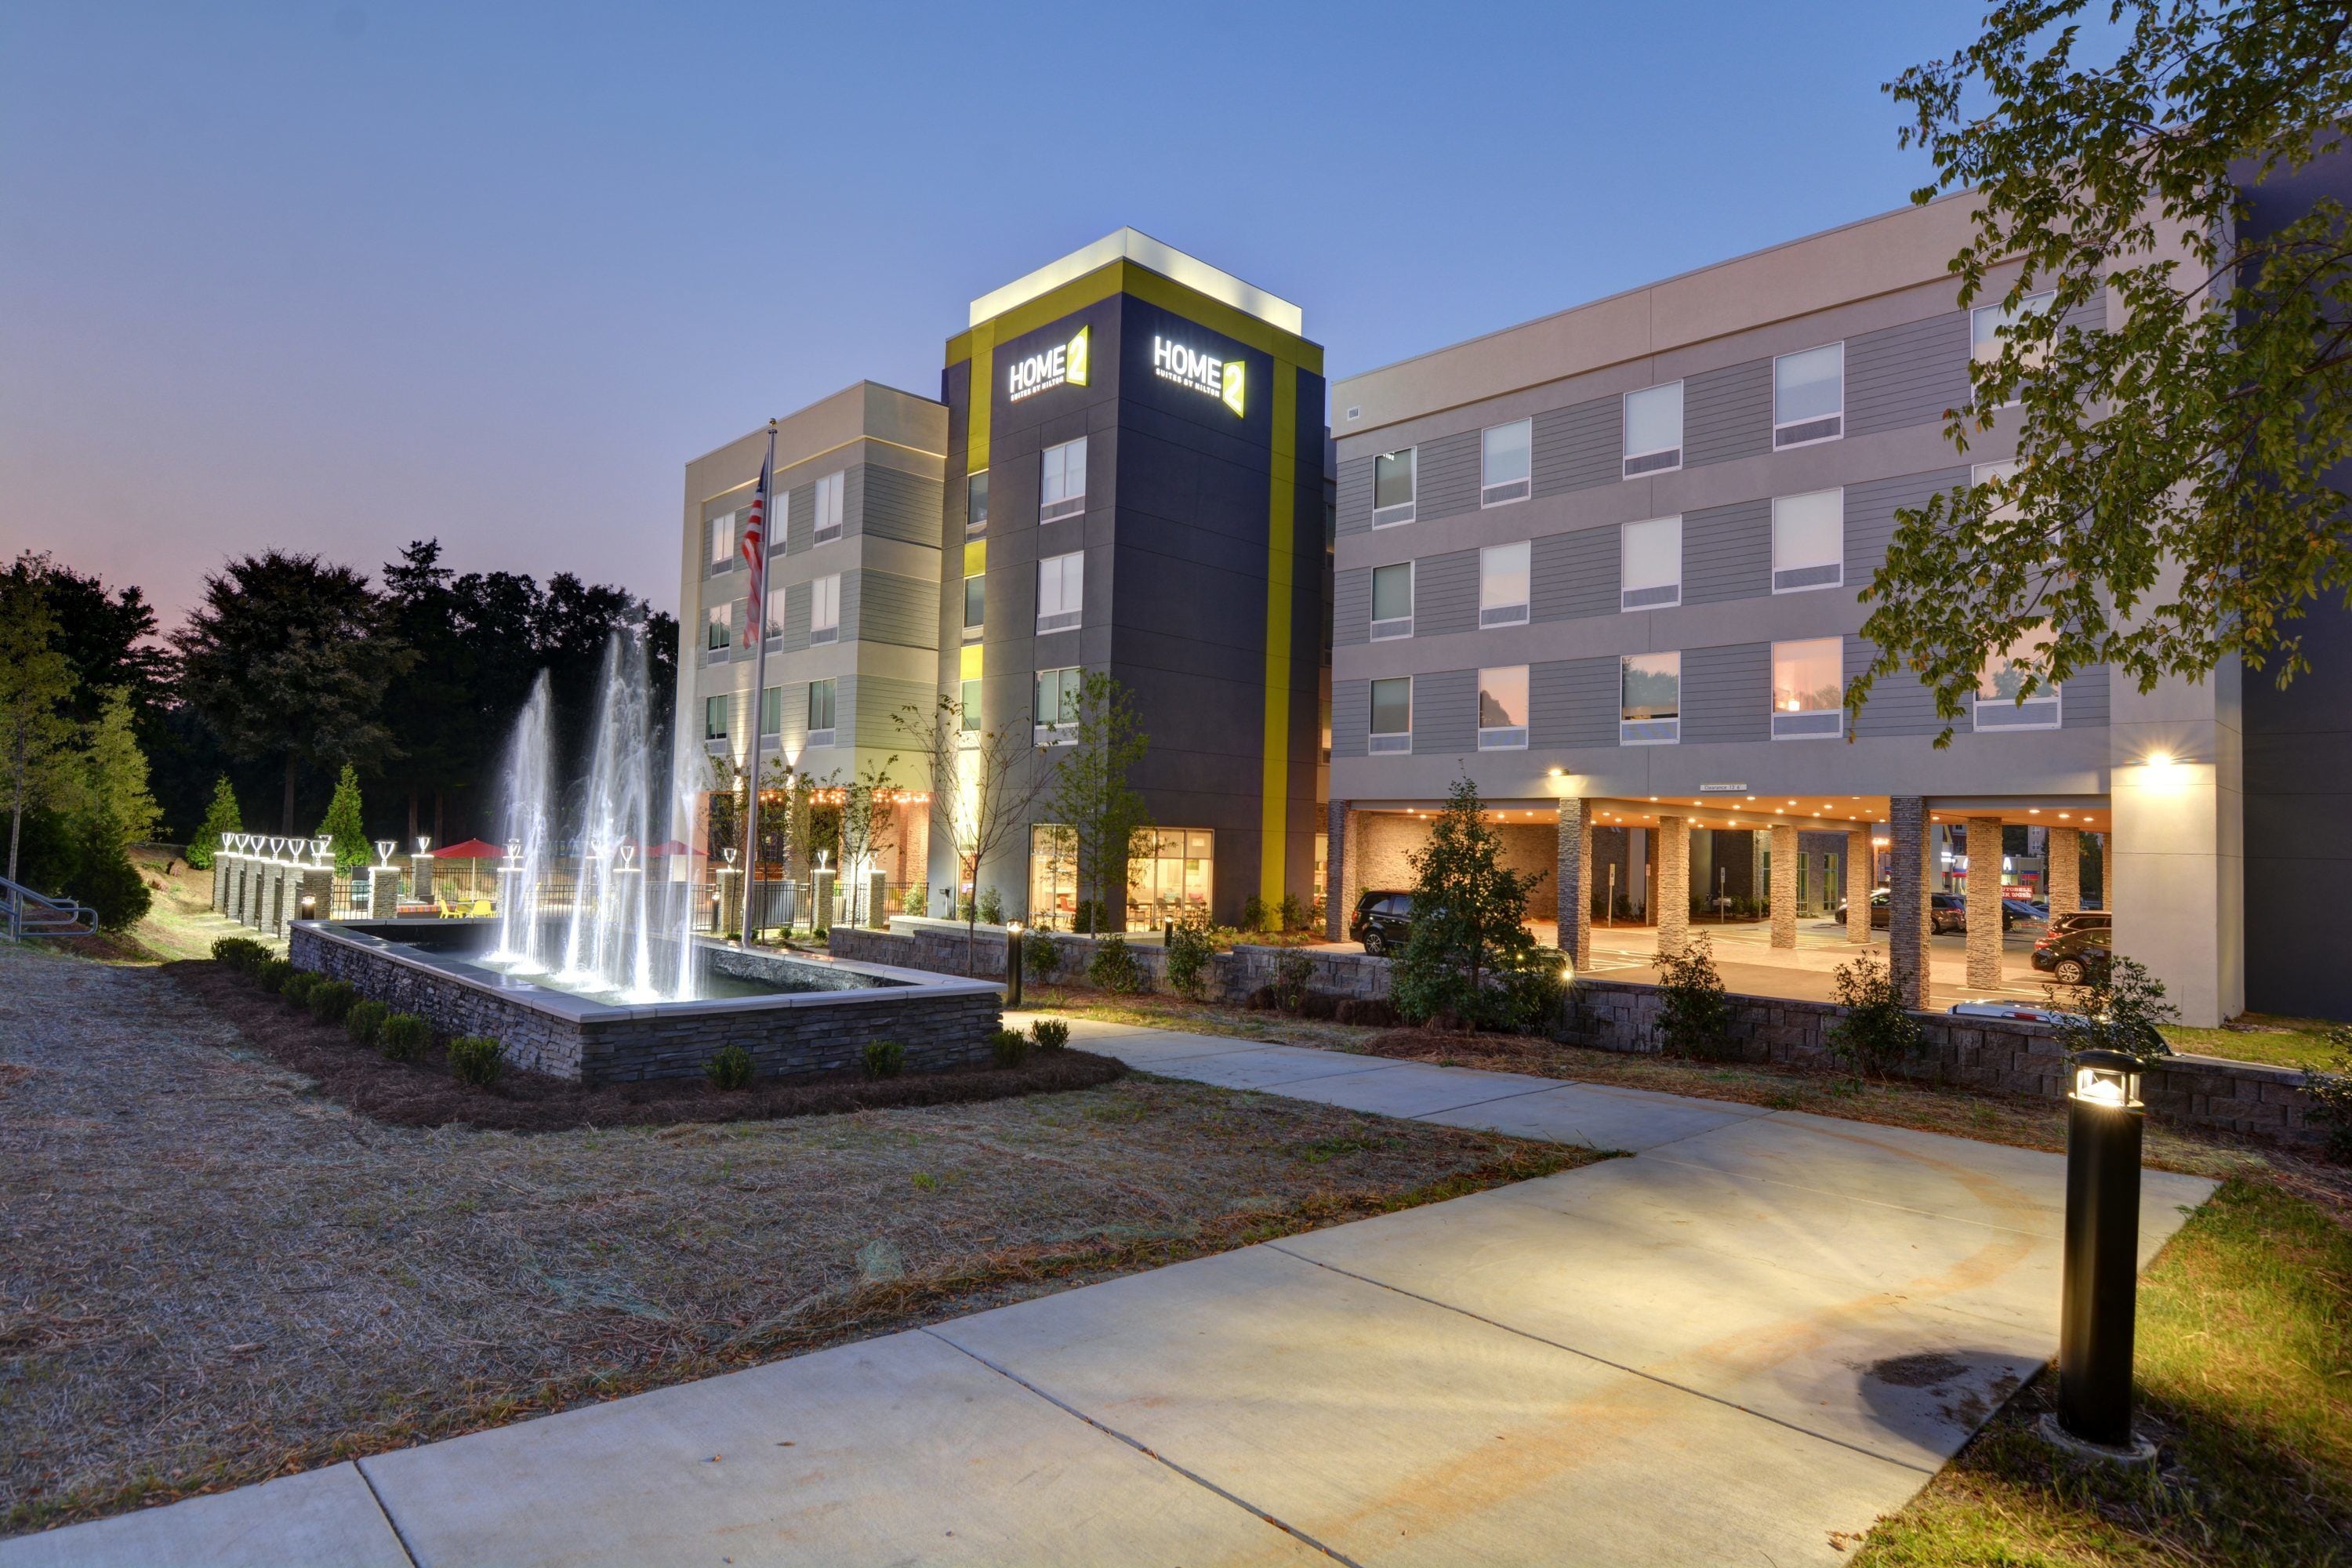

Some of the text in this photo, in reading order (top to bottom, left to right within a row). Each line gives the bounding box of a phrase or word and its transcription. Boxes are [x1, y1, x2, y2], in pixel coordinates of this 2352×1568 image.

[1010, 344, 1066, 394] HOME
[1154, 336, 1221, 390] HOME
[1156, 368, 1220, 398] SUITES BY HILTON
[1011, 375, 1064, 402] SUITES BY HILTON
